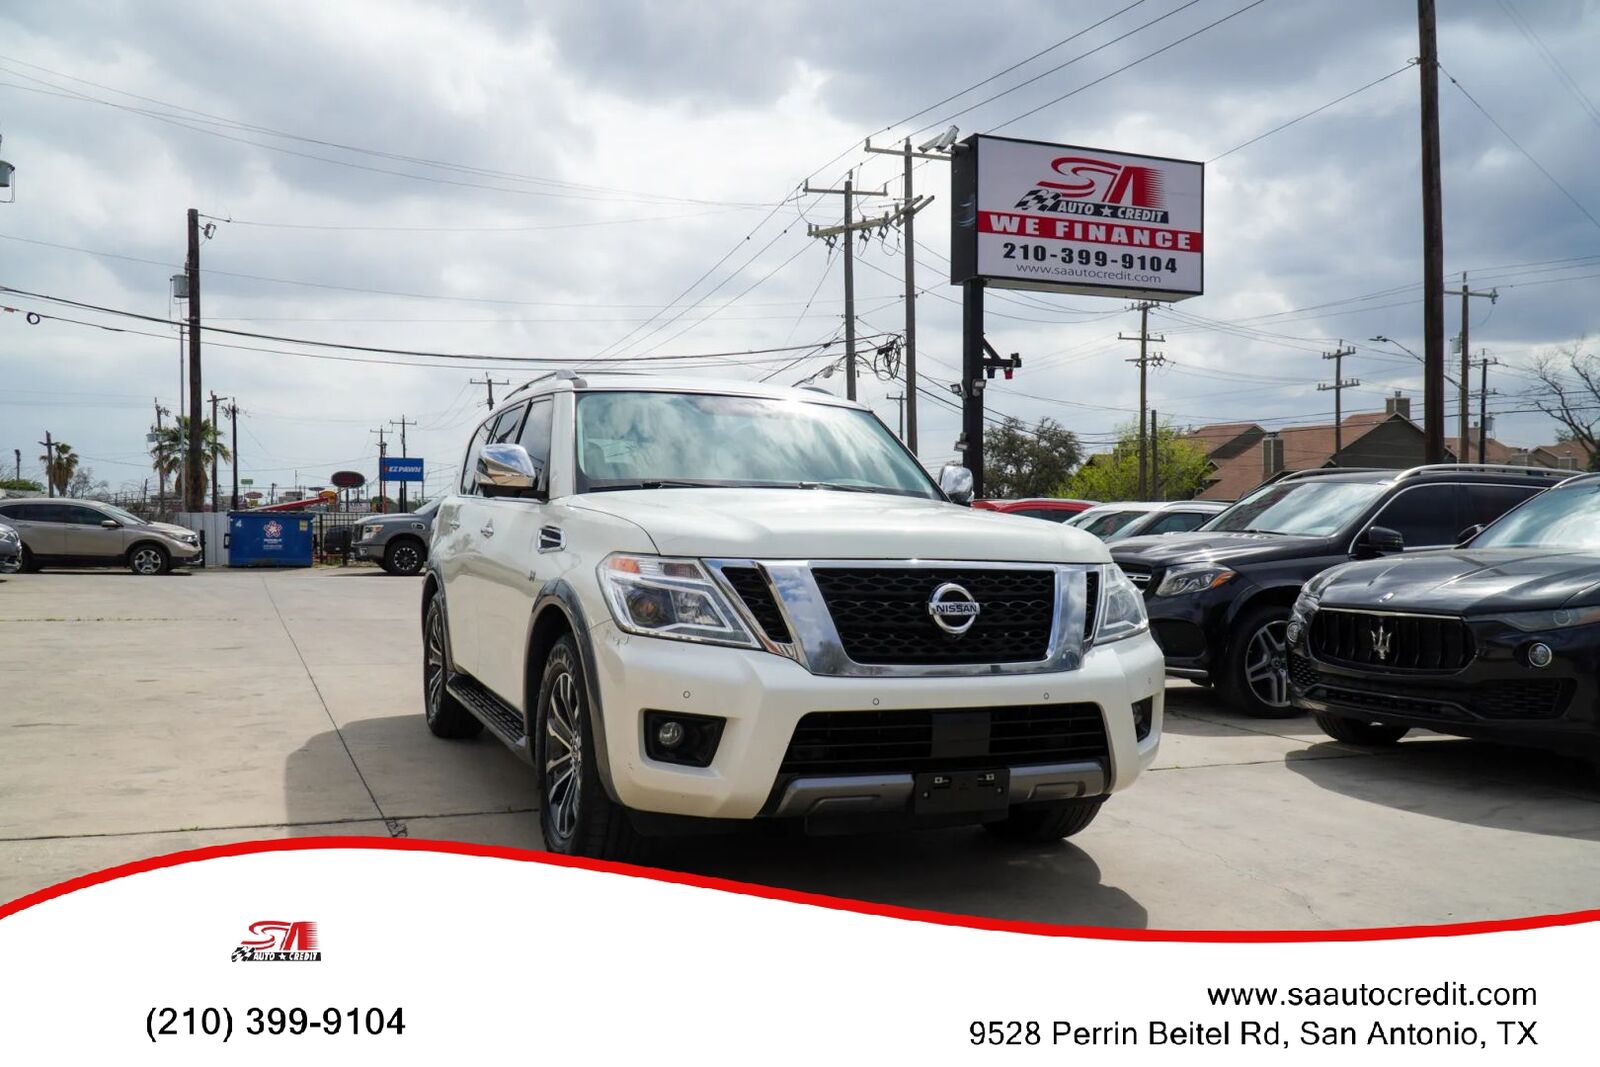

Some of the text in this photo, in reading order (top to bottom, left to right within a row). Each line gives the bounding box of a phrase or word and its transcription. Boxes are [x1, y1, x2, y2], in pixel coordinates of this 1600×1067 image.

[1057, 201, 1165, 223] AUTO CREDIT
[989, 214, 1191, 250] WE FINANCE
[1003, 242, 1177, 273] 210-399-9104
[1016, 263, 1162, 284] www.saautocredit.com
[936, 604, 977, 613] NISSAN
